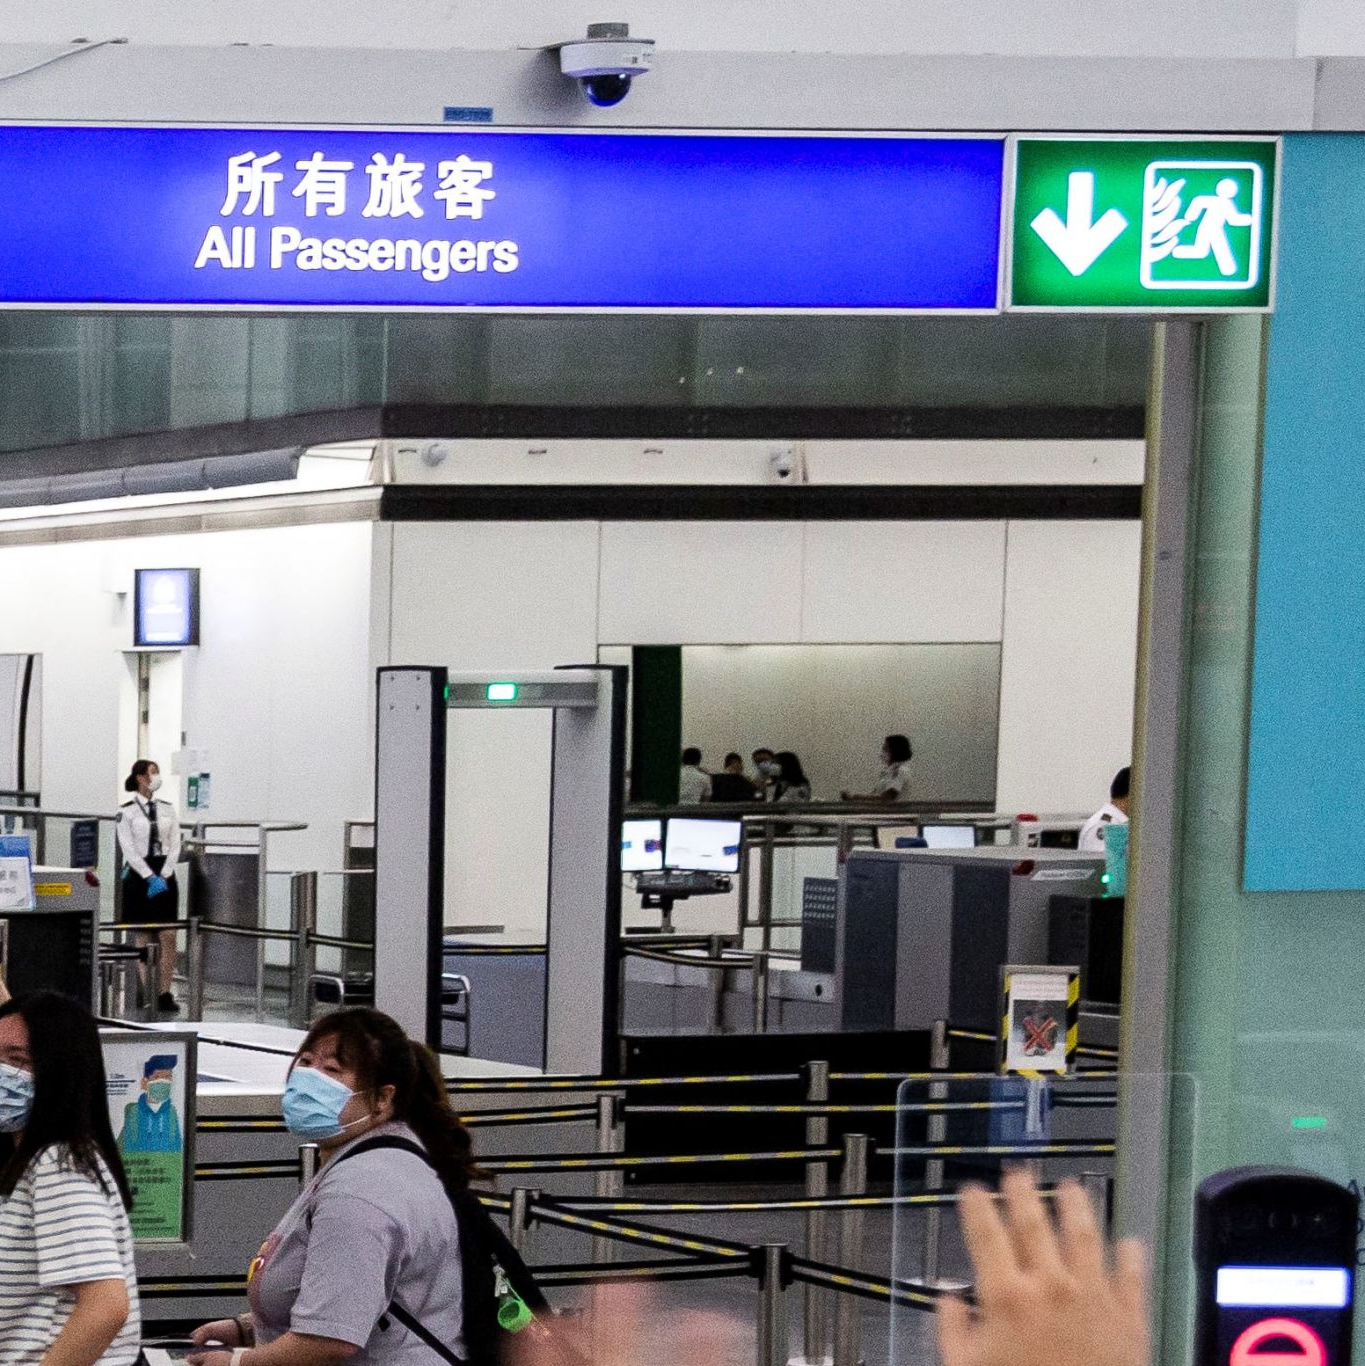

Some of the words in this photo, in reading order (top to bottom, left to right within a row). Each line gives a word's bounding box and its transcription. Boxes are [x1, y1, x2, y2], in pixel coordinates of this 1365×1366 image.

[220, 151, 497, 220] 所有旅客
[194, 225, 256, 269] All
[271, 226, 519, 282] Passengers
